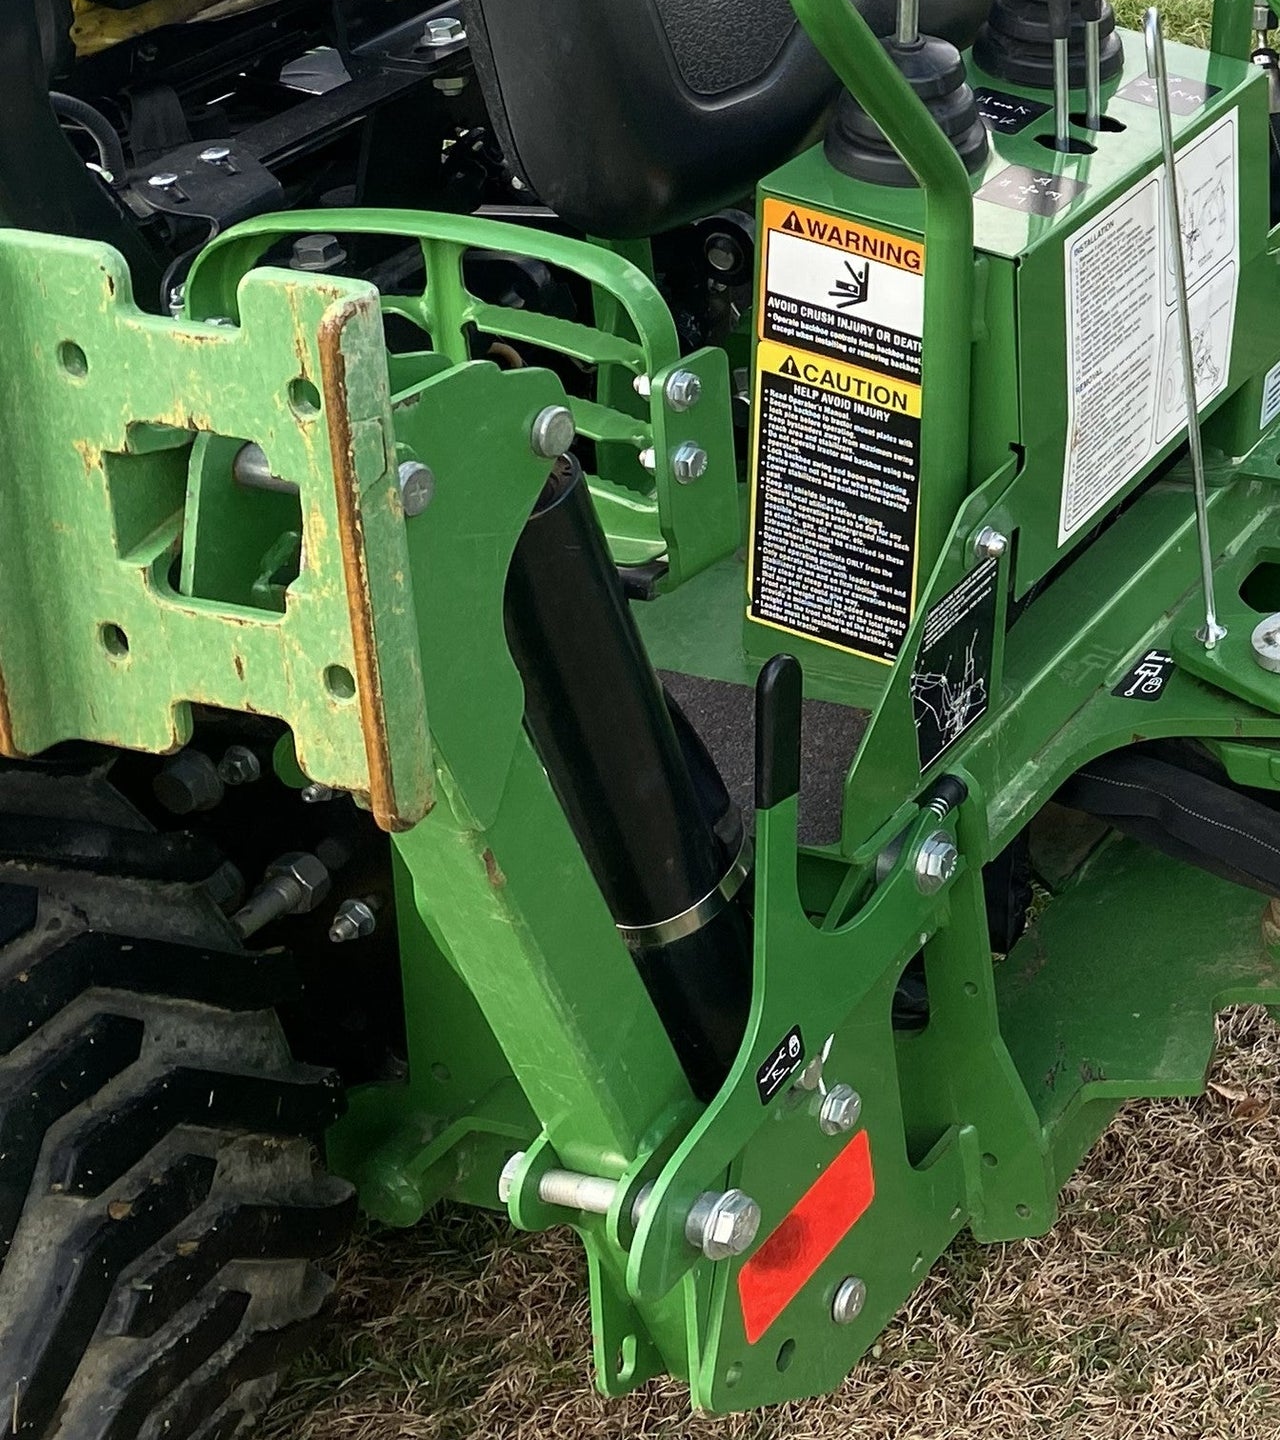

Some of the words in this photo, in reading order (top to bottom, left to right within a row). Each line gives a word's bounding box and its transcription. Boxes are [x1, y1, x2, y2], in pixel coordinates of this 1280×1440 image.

[806, 218, 921, 270] WARNING
[768, 296, 797, 314] AVOID
[800, 306, 834, 325] CRUSH
[837, 317, 873, 337] INJURY
[876, 329, 890, 343] OR
[773, 313, 799, 327] Operate
[800, 321, 828, 335] backhoe
[830, 331, 857, 344] controls
[859, 339, 875, 350] from
[876, 344, 904, 359] backhoe
[772, 324, 794, 336] except
[796, 331, 813, 341] when
[815, 336, 847, 352] installing
[857, 349, 889, 366] removing
[770, 390, 787, 400] Read
[794, 384, 819, 399] HELP
[821, 393, 851, 410] AVOID
[854, 402, 890, 422] INJURY
[803, 363, 908, 411] CAUTION
[768, 423, 786, 433] reach
[788, 429, 803, 438] area
[769, 406, 782, 416] lock
[784, 412, 798, 420] pins
[800, 415, 821, 427] before
[770, 398, 792, 410] Secure
[793, 405, 821, 419] backhoe
[831, 417, 852, 428] tractor
[854, 425, 875, 436] mount
[876, 432, 897, 443] plates
[898, 439, 912, 447] with
[768, 414, 785, 427] Keep
[787, 420, 822, 436] bystanders
[824, 432, 841, 443] away
[842, 437, 858, 447] from
[860, 443, 892, 458] maximum
[894, 454, 913, 465] swing
[790, 438, 815, 450] operate
[817, 445, 839, 457] tractor
[854, 456, 881, 470] backhoe
[883, 467, 901, 478] using
[766, 462, 786, 473] Lower
[788, 469, 821, 484] stabilizers
[837, 484, 858, 496] bucket
[860, 490, 881, 502] before
[882, 498, 906, 512] leaving
[766, 477, 782, 488] Keep
[794, 487, 818, 499] shields
[767, 446, 782, 456] Lock
[784, 451, 810, 465] backhoe
[812, 461, 832, 472] swing
[847, 470, 866, 482] boom
[867, 478, 881, 486] with
[883, 481, 906, 496] locking
[767, 454, 788, 466] device
[790, 462, 807, 472] when
[851, 481, 868, 491] when
[765, 493, 784, 504] Check
[798, 504, 829, 520] operating
[831, 514, 845, 524] area
[766, 485, 790, 498] Consult
[791, 493, 807, 504] local
[809, 500, 834, 512] utilities
[836, 507, 856, 519] before
[764, 525, 782, 535] areas
[784, 531, 803, 542] where
[764, 516, 790, 530] Extreme
[792, 526, 816, 538] caution
[818, 534, 833, 544] must
[845, 543, 876, 557] exercised
[886, 554, 904, 565] these
[765, 502, 792, 516] possible
[794, 511, 824, 524] overhead
[834, 524, 874, 540] underground
[876, 536, 892, 546] lines
[894, 542, 909, 551] such
[763, 540, 786, 552] normal
[788, 548, 818, 564] operating
[763, 556, 795, 570] stabilizers
[797, 566, 814, 576] down
[763, 547, 777, 558] Only
[778, 553, 803, 565] operate
[805, 561, 831, 574] backhoe
[849, 574, 870, 586] loader
[871, 581, 892, 593] bucket
[764, 532, 788, 545] Operate
[790, 540, 817, 554] backhoe
[819, 550, 844, 563] controls
[846, 558, 864, 568] ONLY
[865, 564, 880, 574] from
[762, 562, 776, 574] Stay
[778, 568, 794, 578] clear
[804, 577, 822, 588] steep
[823, 583, 841, 593] areas
[851, 592, 886, 606] excavation
[887, 602, 906, 613] banks
[762, 578, 778, 588] Front
[793, 589, 814, 600] weight
[844, 605, 863, 615] added
[874, 614, 898, 626] needed
[810, 587, 828, 596] could
[760, 608, 788, 622] attached
[760, 600, 782, 612] Loader
[811, 617, 839, 631] installed
[859, 632, 886, 646] backhoe
[761, 594, 782, 605] weight
[805, 607, 820, 617] front
[822, 614, 844, 625] wheels
[761, 586, 785, 599] provide
[868, 620, 883, 629] total
[885, 626, 902, 636] gross
